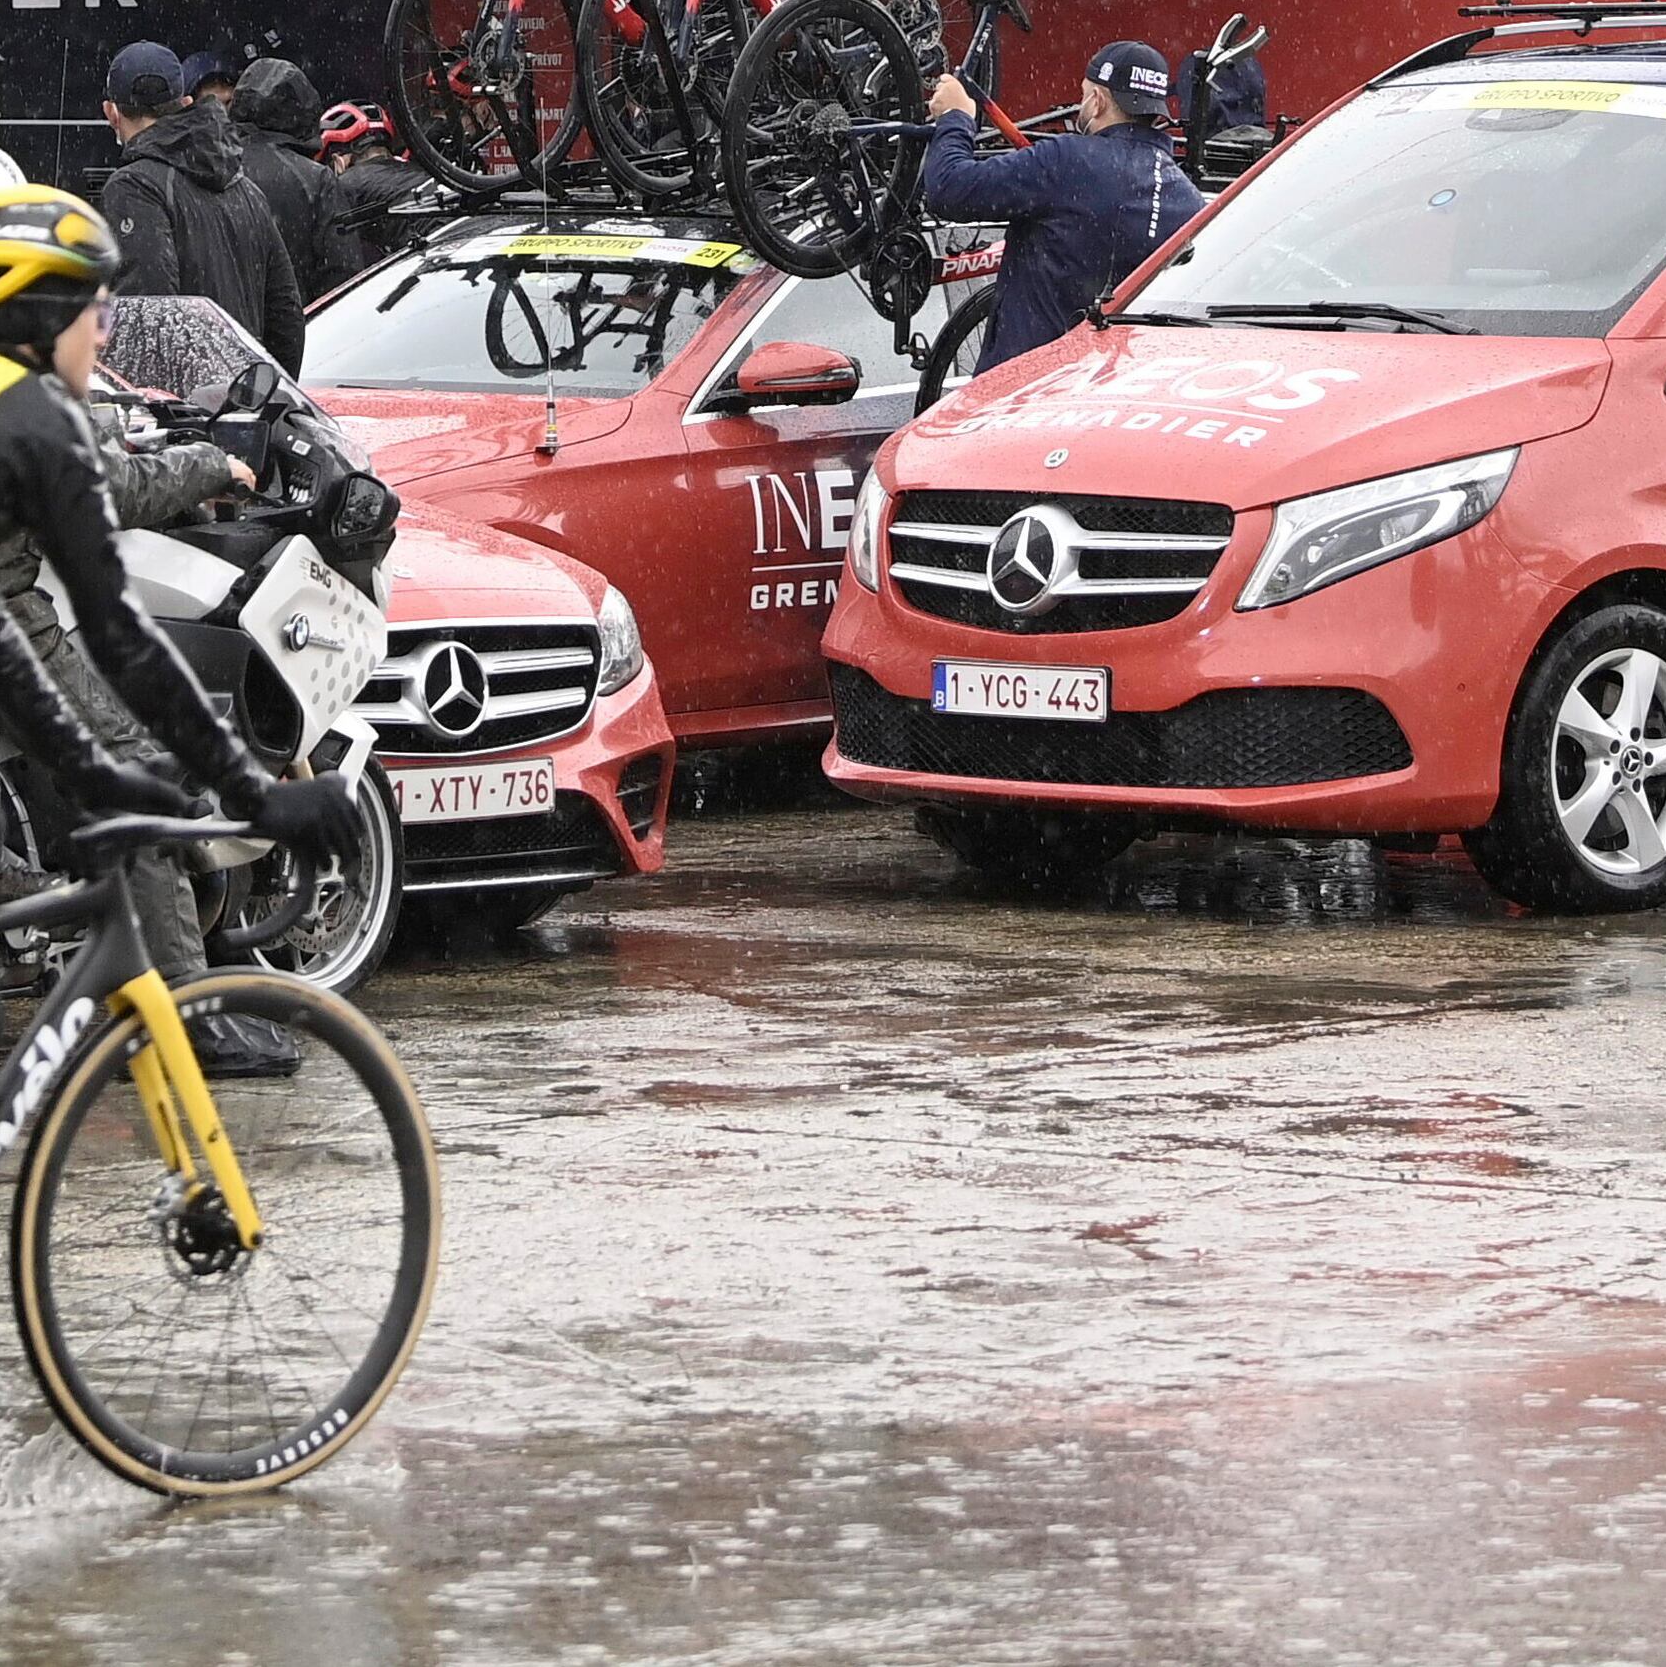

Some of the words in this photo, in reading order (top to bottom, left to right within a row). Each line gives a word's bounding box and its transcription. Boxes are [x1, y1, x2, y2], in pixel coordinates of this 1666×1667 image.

[1130, 66, 1169, 87] INEOS
[1473, 88, 1535, 103] GRUPPO
[1537, 88, 1621, 104] SPORTIVO
[508, 236, 568, 249] GRUPPO
[568, 237, 643, 251] SPORTIVO
[695, 246, 726, 261] 231
[941, 252, 1004, 278] PINAR
[745, 469, 855, 555] INE
[310, 560, 332, 589] EMG
[935, 690, 946, 707] B
[950, 671, 1100, 713] 1-YCG-443
